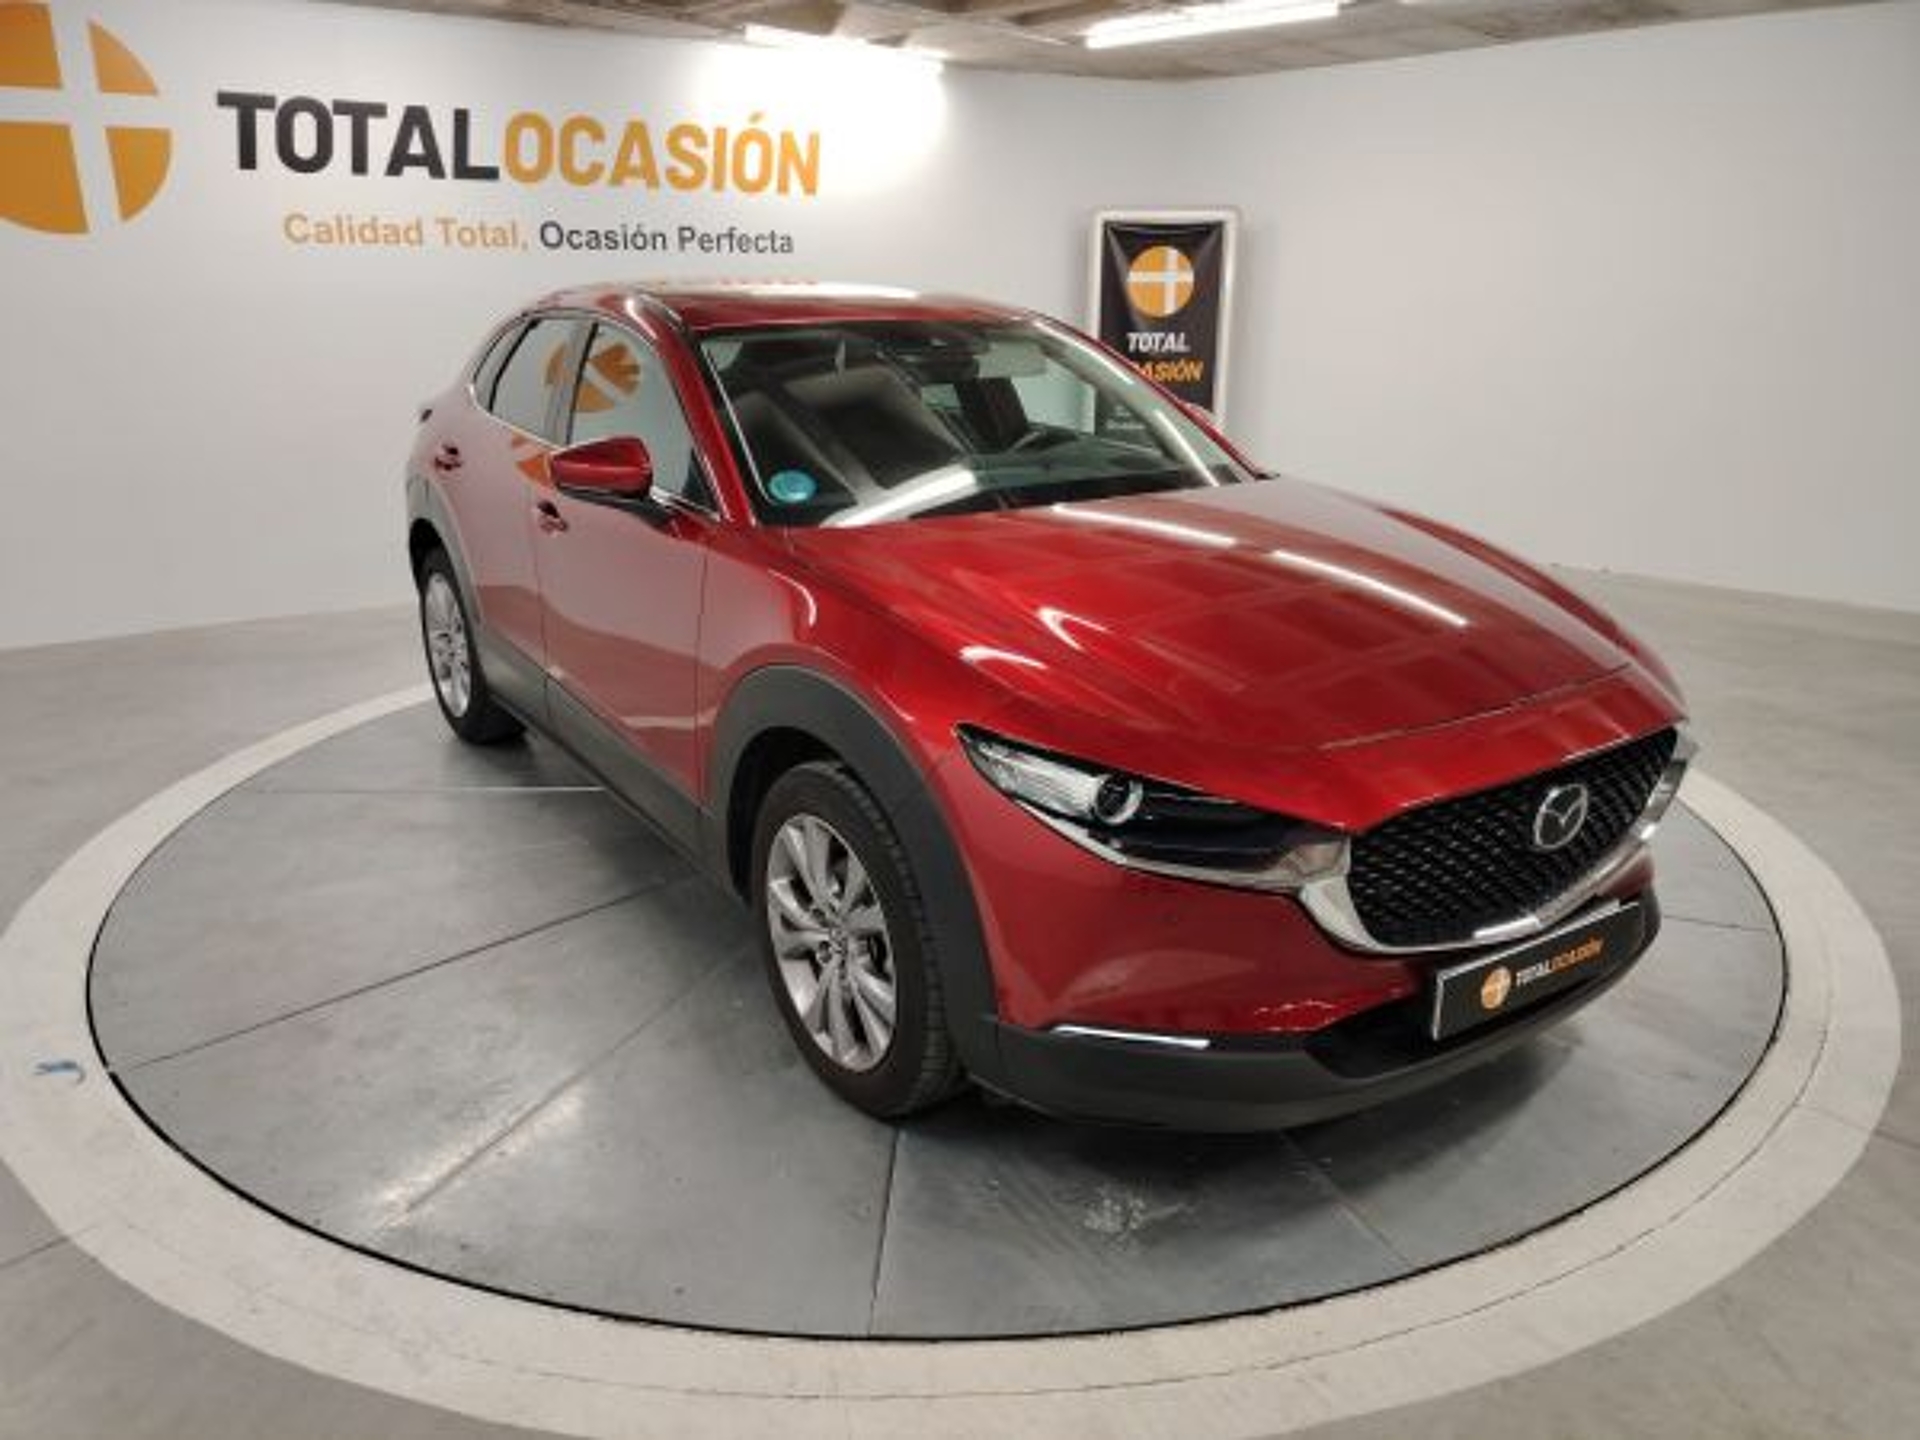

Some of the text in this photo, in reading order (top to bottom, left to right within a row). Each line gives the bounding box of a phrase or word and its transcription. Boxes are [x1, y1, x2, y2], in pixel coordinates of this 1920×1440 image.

[283, 213, 795, 255] Calidad Total, Ocasión Perfecta
[1127, 332, 1191, 353] TOTAL
